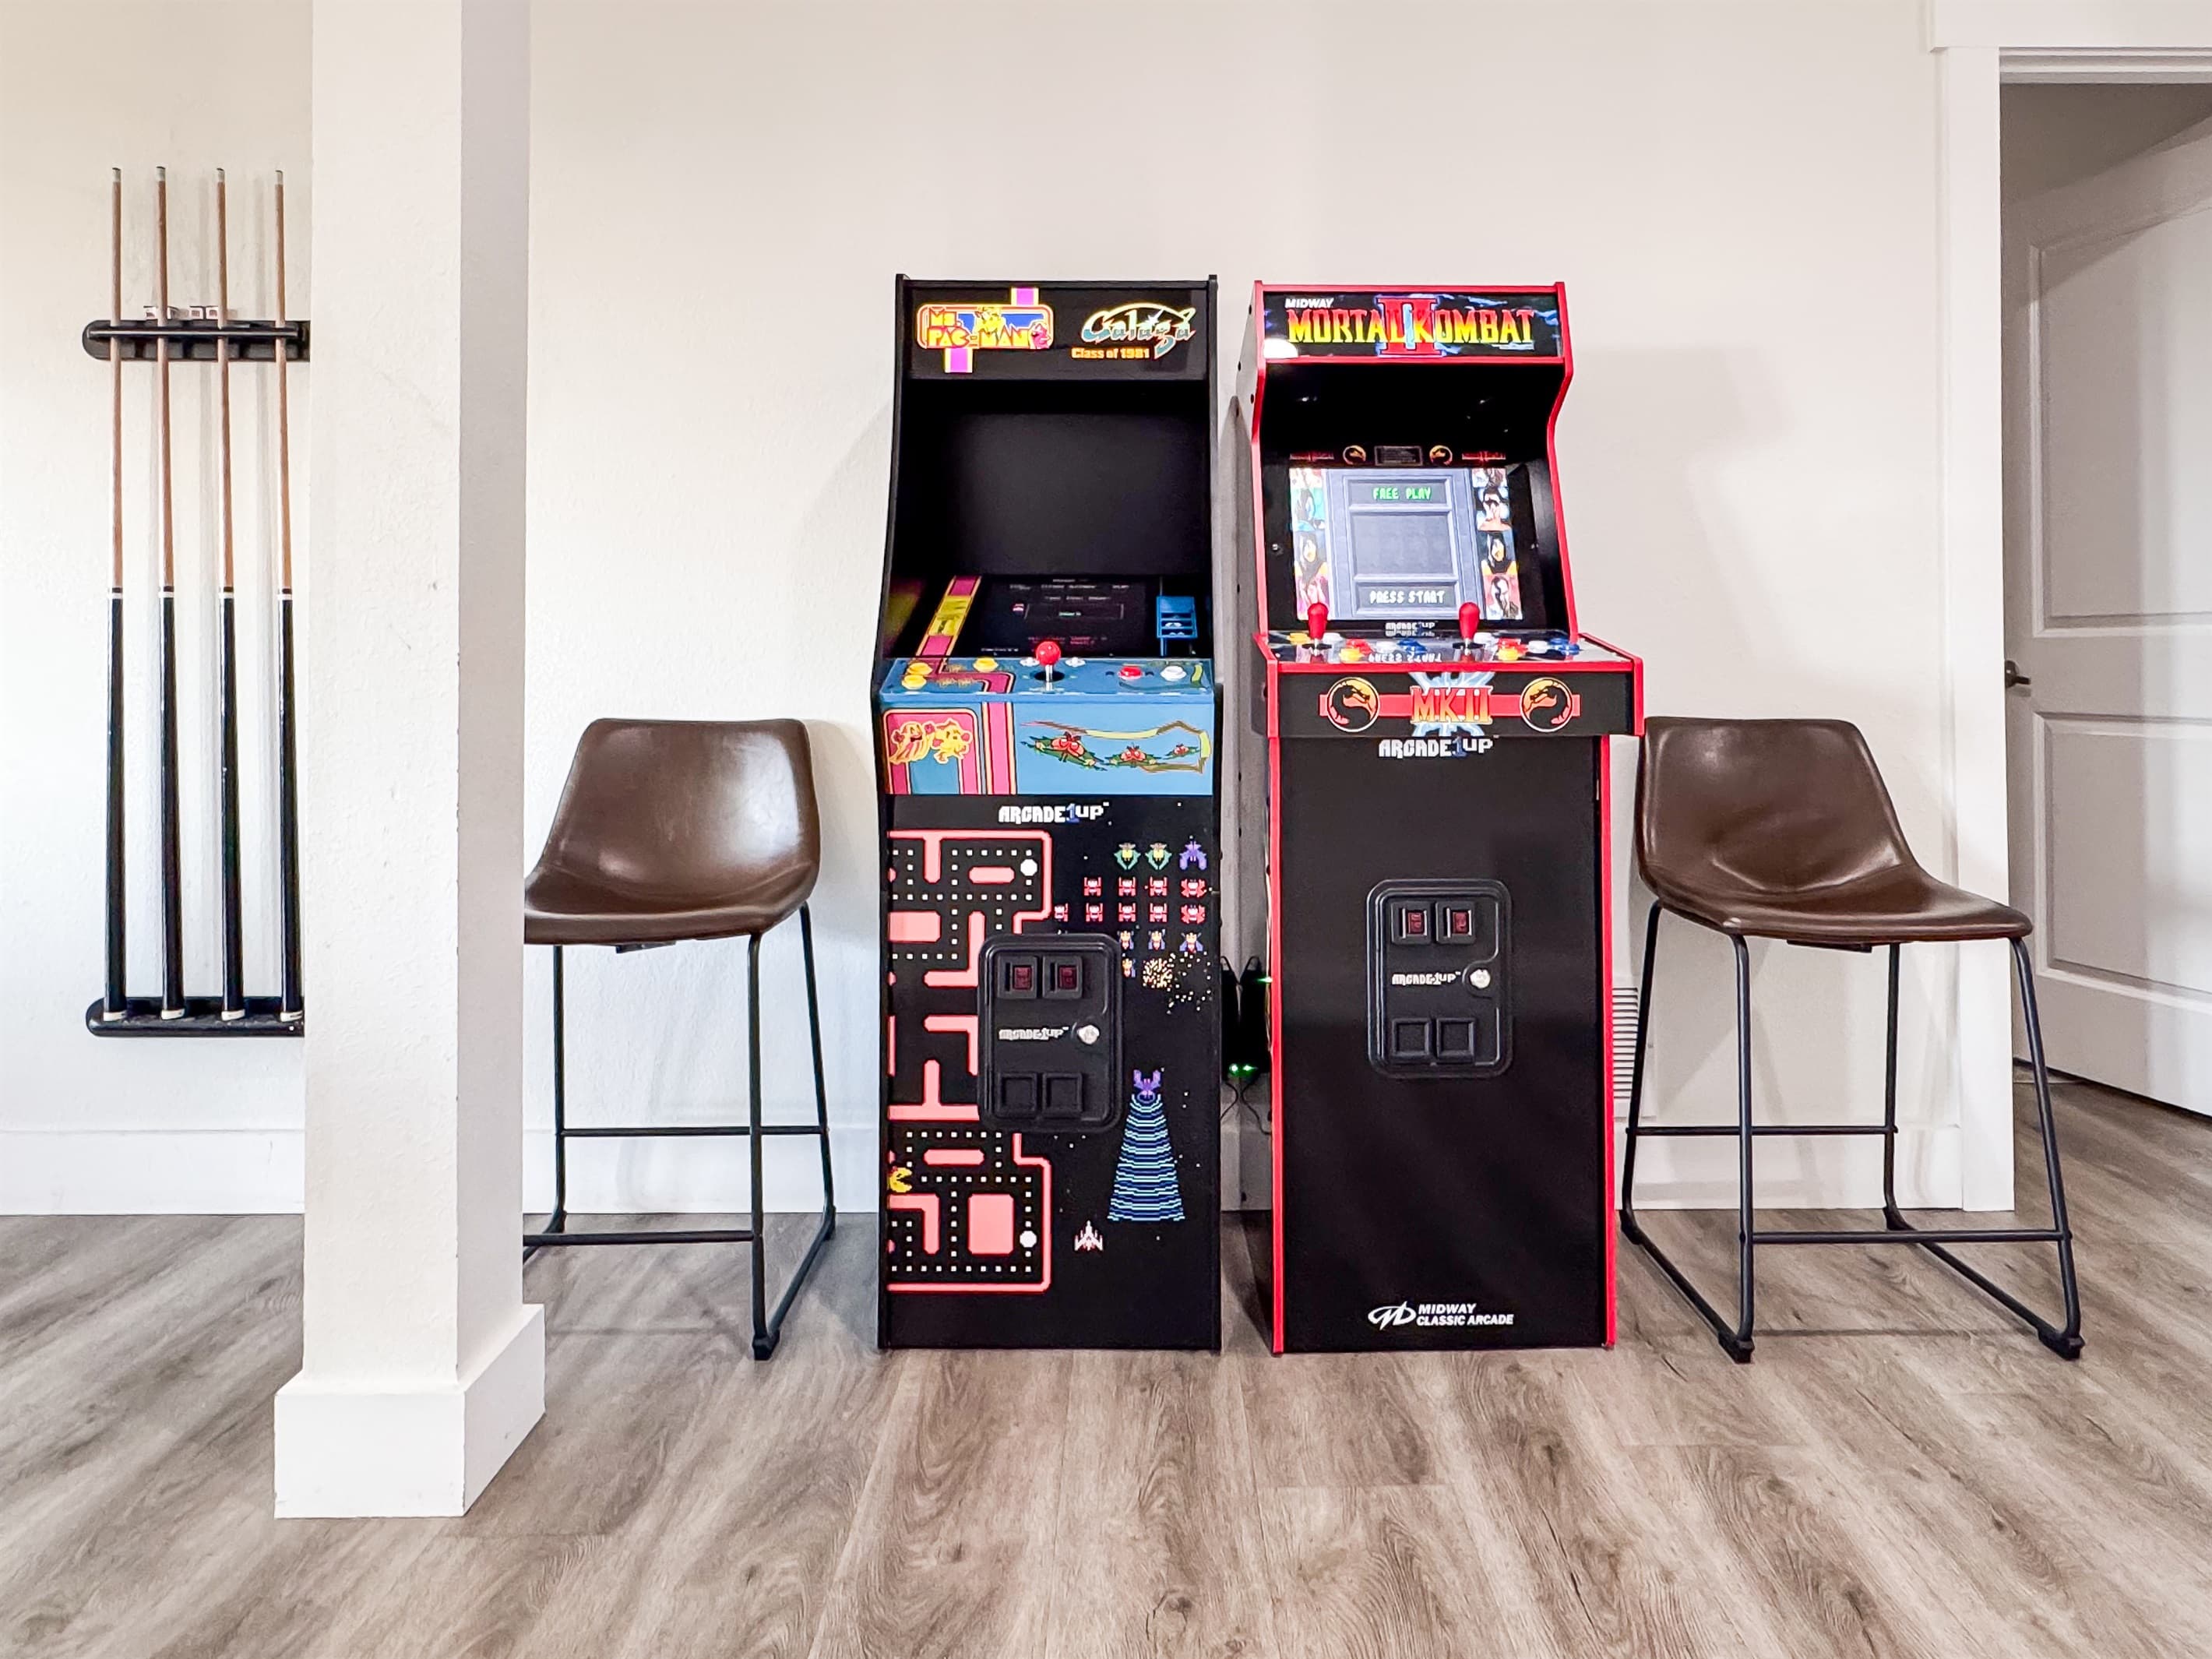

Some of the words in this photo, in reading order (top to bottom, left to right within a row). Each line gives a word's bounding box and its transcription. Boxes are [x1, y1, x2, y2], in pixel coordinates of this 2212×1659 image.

[1284, 298, 1334, 308] MIDWAY
[1287, 308, 1405, 343] MORTAL
[1412, 308, 1534, 343] KOMBAT
[927, 325, 1030, 348] PAC-MAN
[1071, 347, 1104, 359] Class
[1106, 347, 1119, 359] of
[1120, 347, 1150, 359] 1981
[1372, 487, 1400, 500] FREE
[1406, 487, 1432, 500] PLAY
[1369, 590, 1404, 604] PRESS
[1407, 590, 1445, 604] START
[1410, 685, 1494, 725] MKII
[1418, 1303, 1477, 1315] MIDWAY
[1416, 1315, 1465, 1326] CLASSIC
[1467, 1314, 1515, 1326] ARCADE
